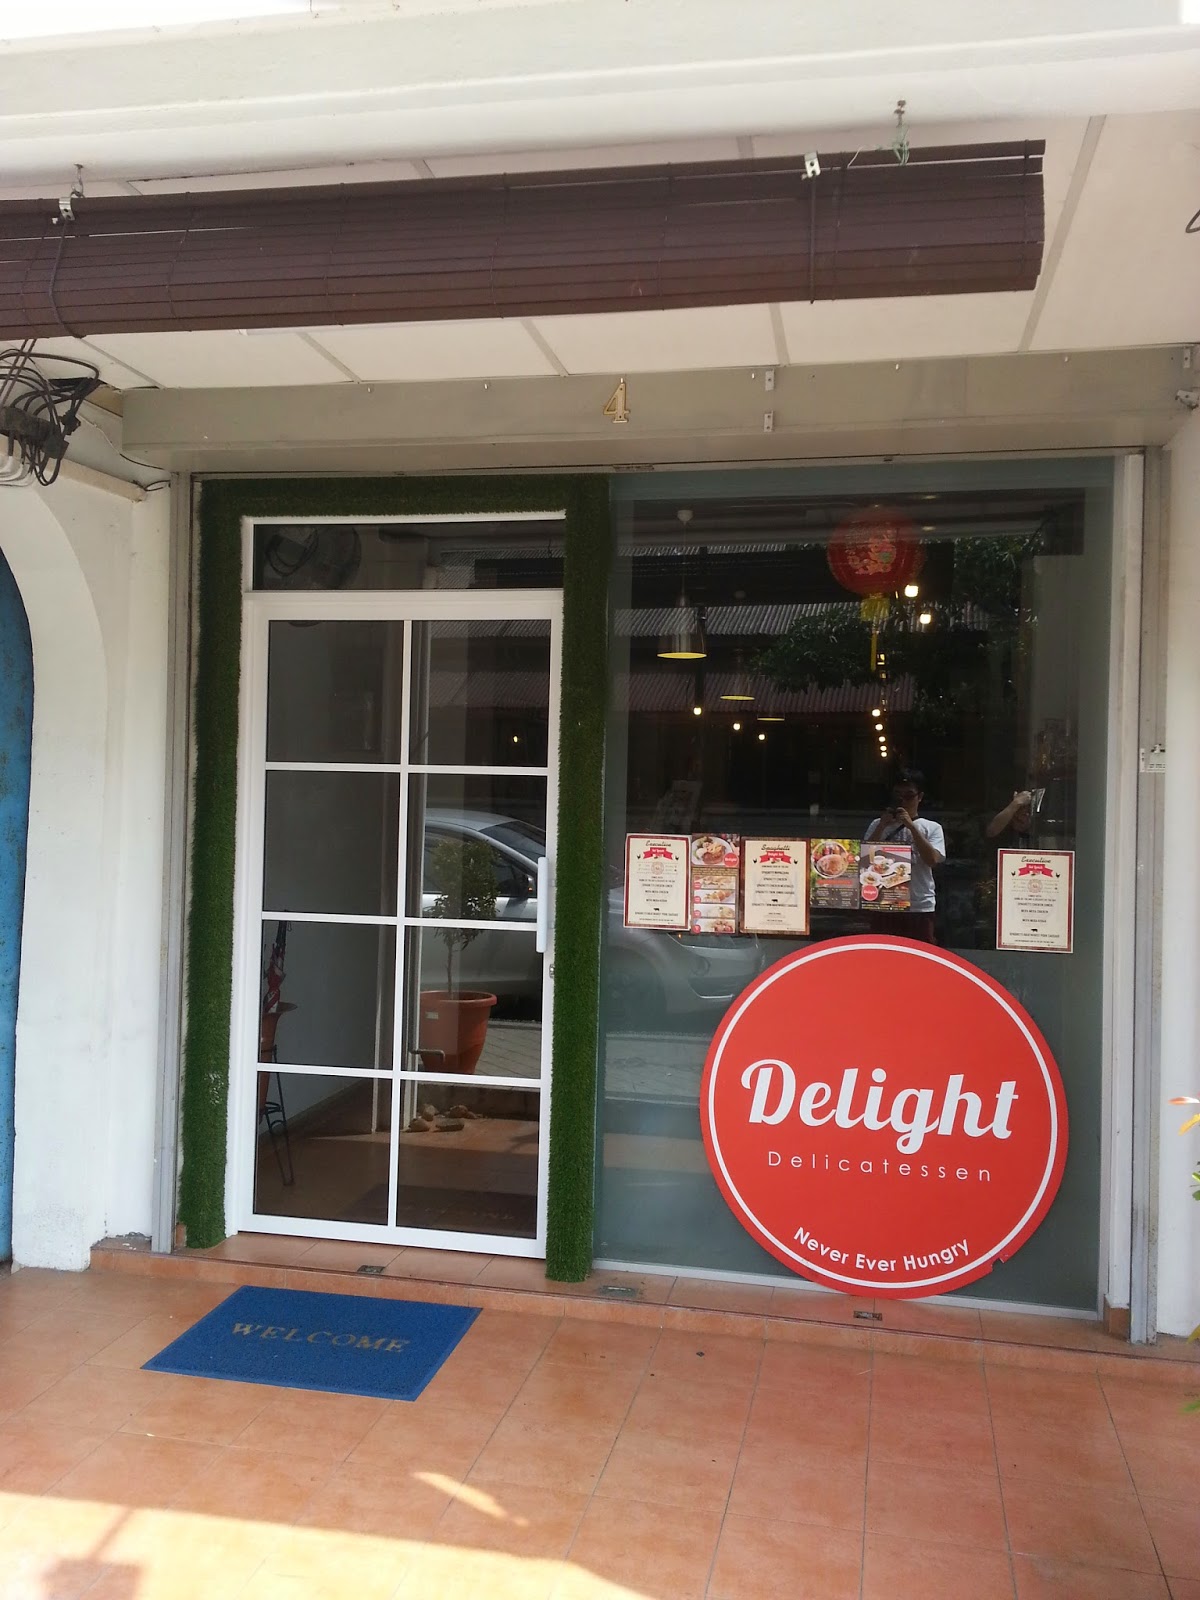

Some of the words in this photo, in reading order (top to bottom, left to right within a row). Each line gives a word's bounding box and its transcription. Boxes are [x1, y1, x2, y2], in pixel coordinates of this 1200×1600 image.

[603, 383, 630, 423] 4
[761, 843, 790, 851] Spaghetti
[1021, 855, 1052, 863] Executive
[741, 1059, 1019, 1154] Delight
[768, 1151, 991, 1182] Delicatessen
[793, 1226, 849, 1265] Never
[855, 1253, 896, 1272] Ever
[903, 1239, 970, 1271] Hungry
[232, 1322, 411, 1353] WELCOME
